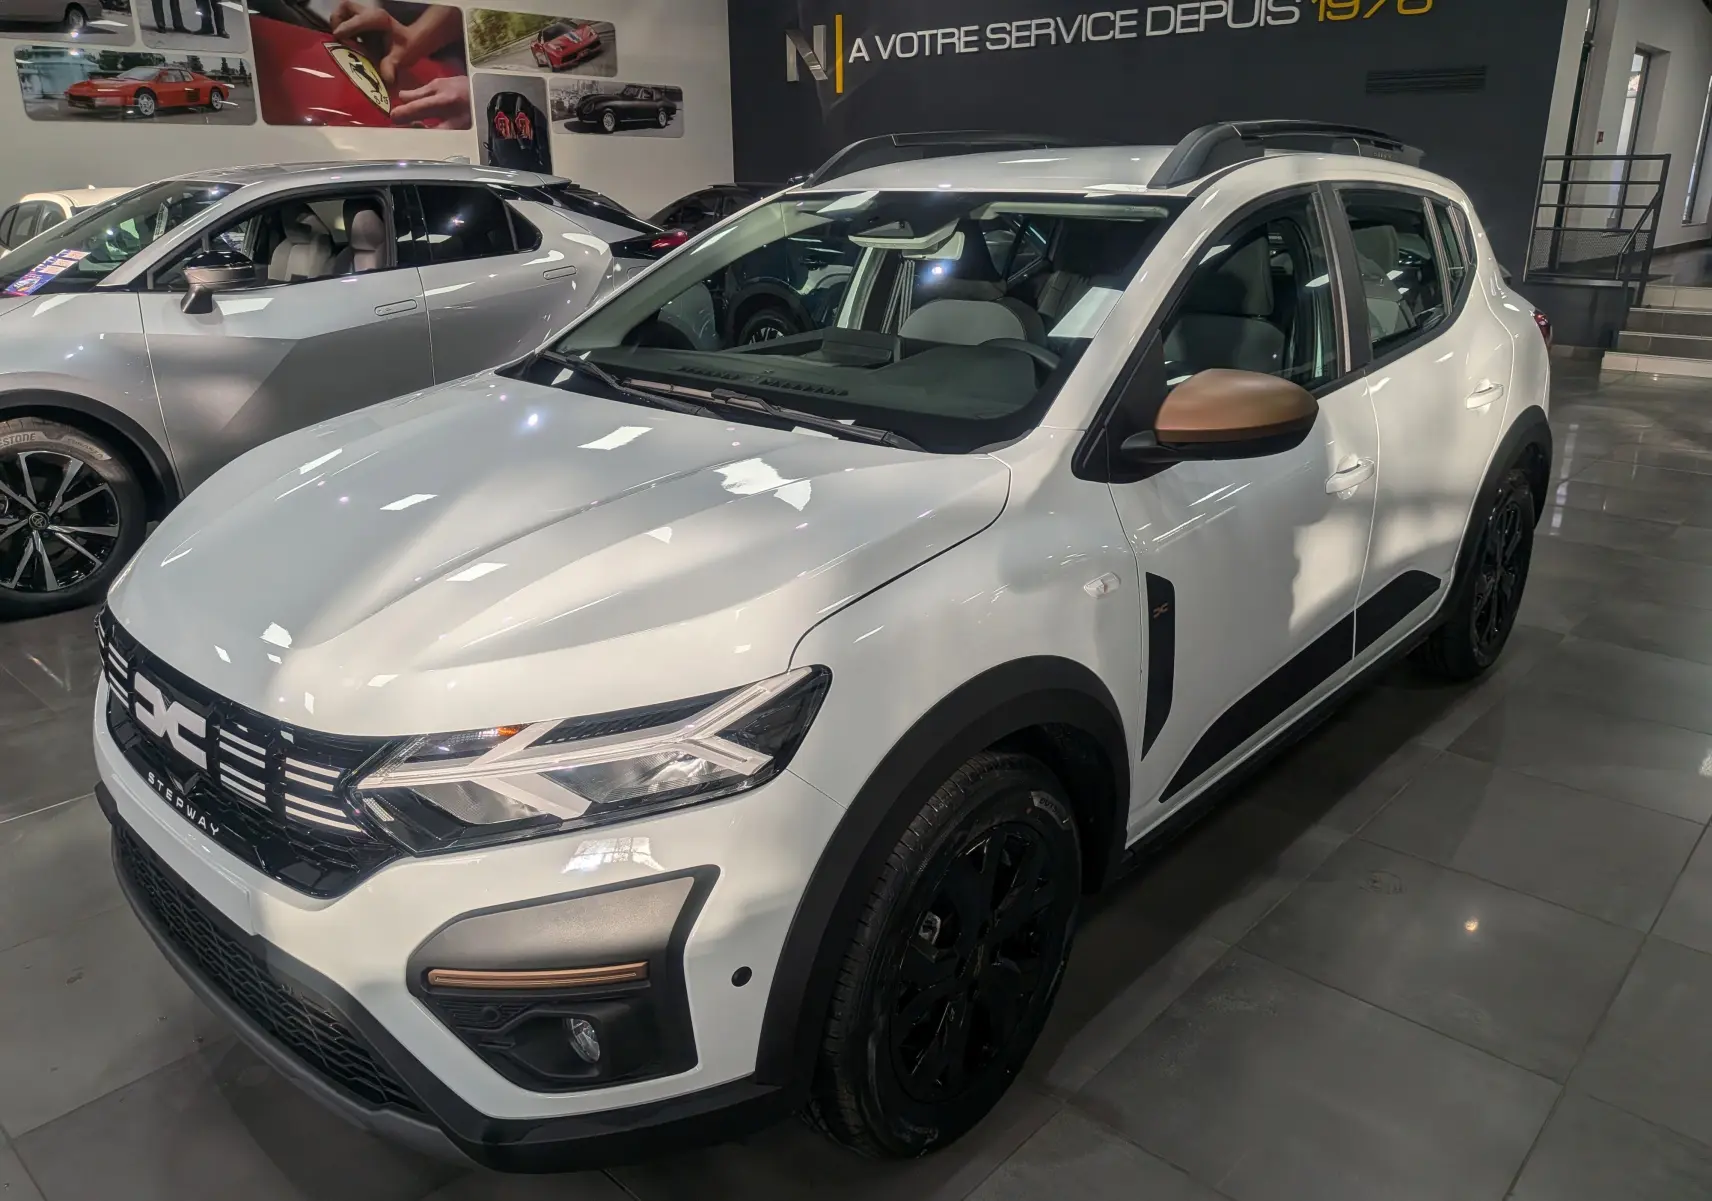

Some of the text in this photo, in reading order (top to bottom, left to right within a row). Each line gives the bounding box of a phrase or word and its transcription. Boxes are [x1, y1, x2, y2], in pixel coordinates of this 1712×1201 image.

[848, 37, 871, 63] A
[874, 25, 979, 60] VOTRE
[985, 9, 1138, 51] SERVICE
[1145, 0, 1300, 36] DEPUIS
[0, 432, 36, 446] STONE
[147, 771, 219, 836] STEPWAY
